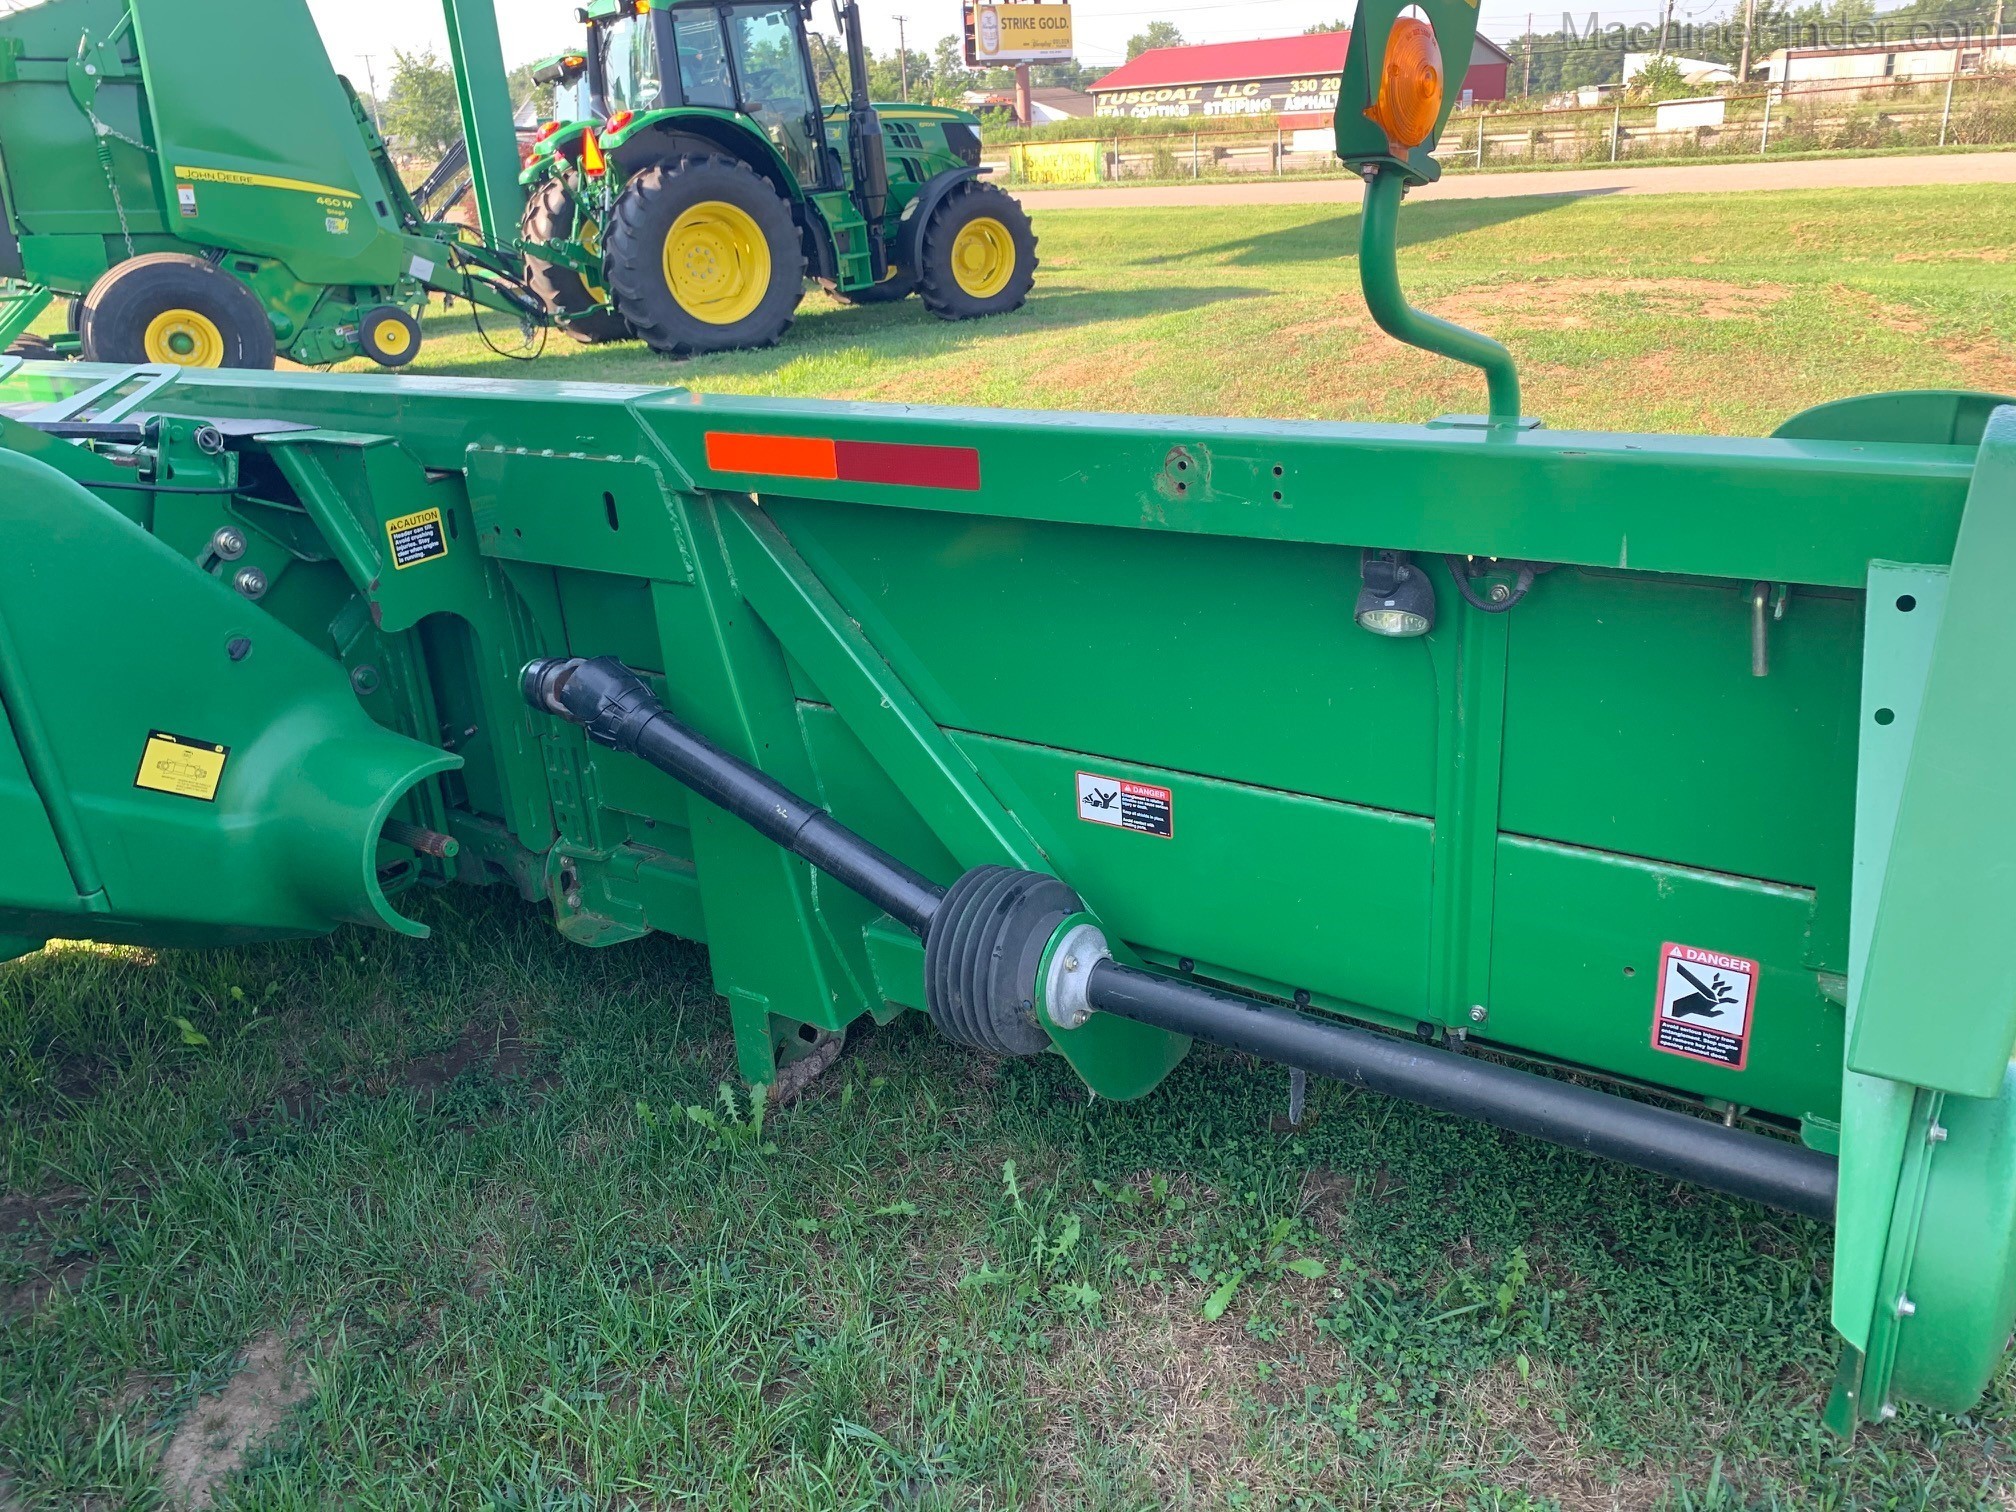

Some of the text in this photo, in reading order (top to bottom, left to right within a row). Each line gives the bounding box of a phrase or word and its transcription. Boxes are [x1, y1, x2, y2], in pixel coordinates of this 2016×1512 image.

[1001, 17, 1069, 30] STRIKE GOLD.
[1098, 86, 1202, 106] TUSCOAT
[1213, 83, 1260, 98] LLC
[1290, 79, 1318, 93] 330
[1130, 104, 1190, 118] COATING
[1203, 97, 1272, 116] STRIPING
[1284, 94, 1340, 110] ASPHALT
[185, 170, 254, 184] JOHN DEERE
[316, 197, 353, 210] 460 M
[396, 510, 438, 529] CAUTION
[393, 530, 412, 540] Header
[395, 530, 434, 546] Avoid crushing
[423, 541, 439, 550] engine
[404, 552, 425, 561] running.
[1133, 786, 1166, 798] DANGER
[1686, 949, 1751, 972] DANGER
[1661, 1029, 1702, 1041] entanglement.
[1718, 1043, 1738, 1051] engine
[1680, 1027, 1702, 1035] serious
[1703, 1032, 1720, 1041] injury
[1660, 1040, 1730, 1061] opening cleanout doors.
[1672, 1037, 1694, 1046] remove
[1706, 1045, 1726, 1054] before
